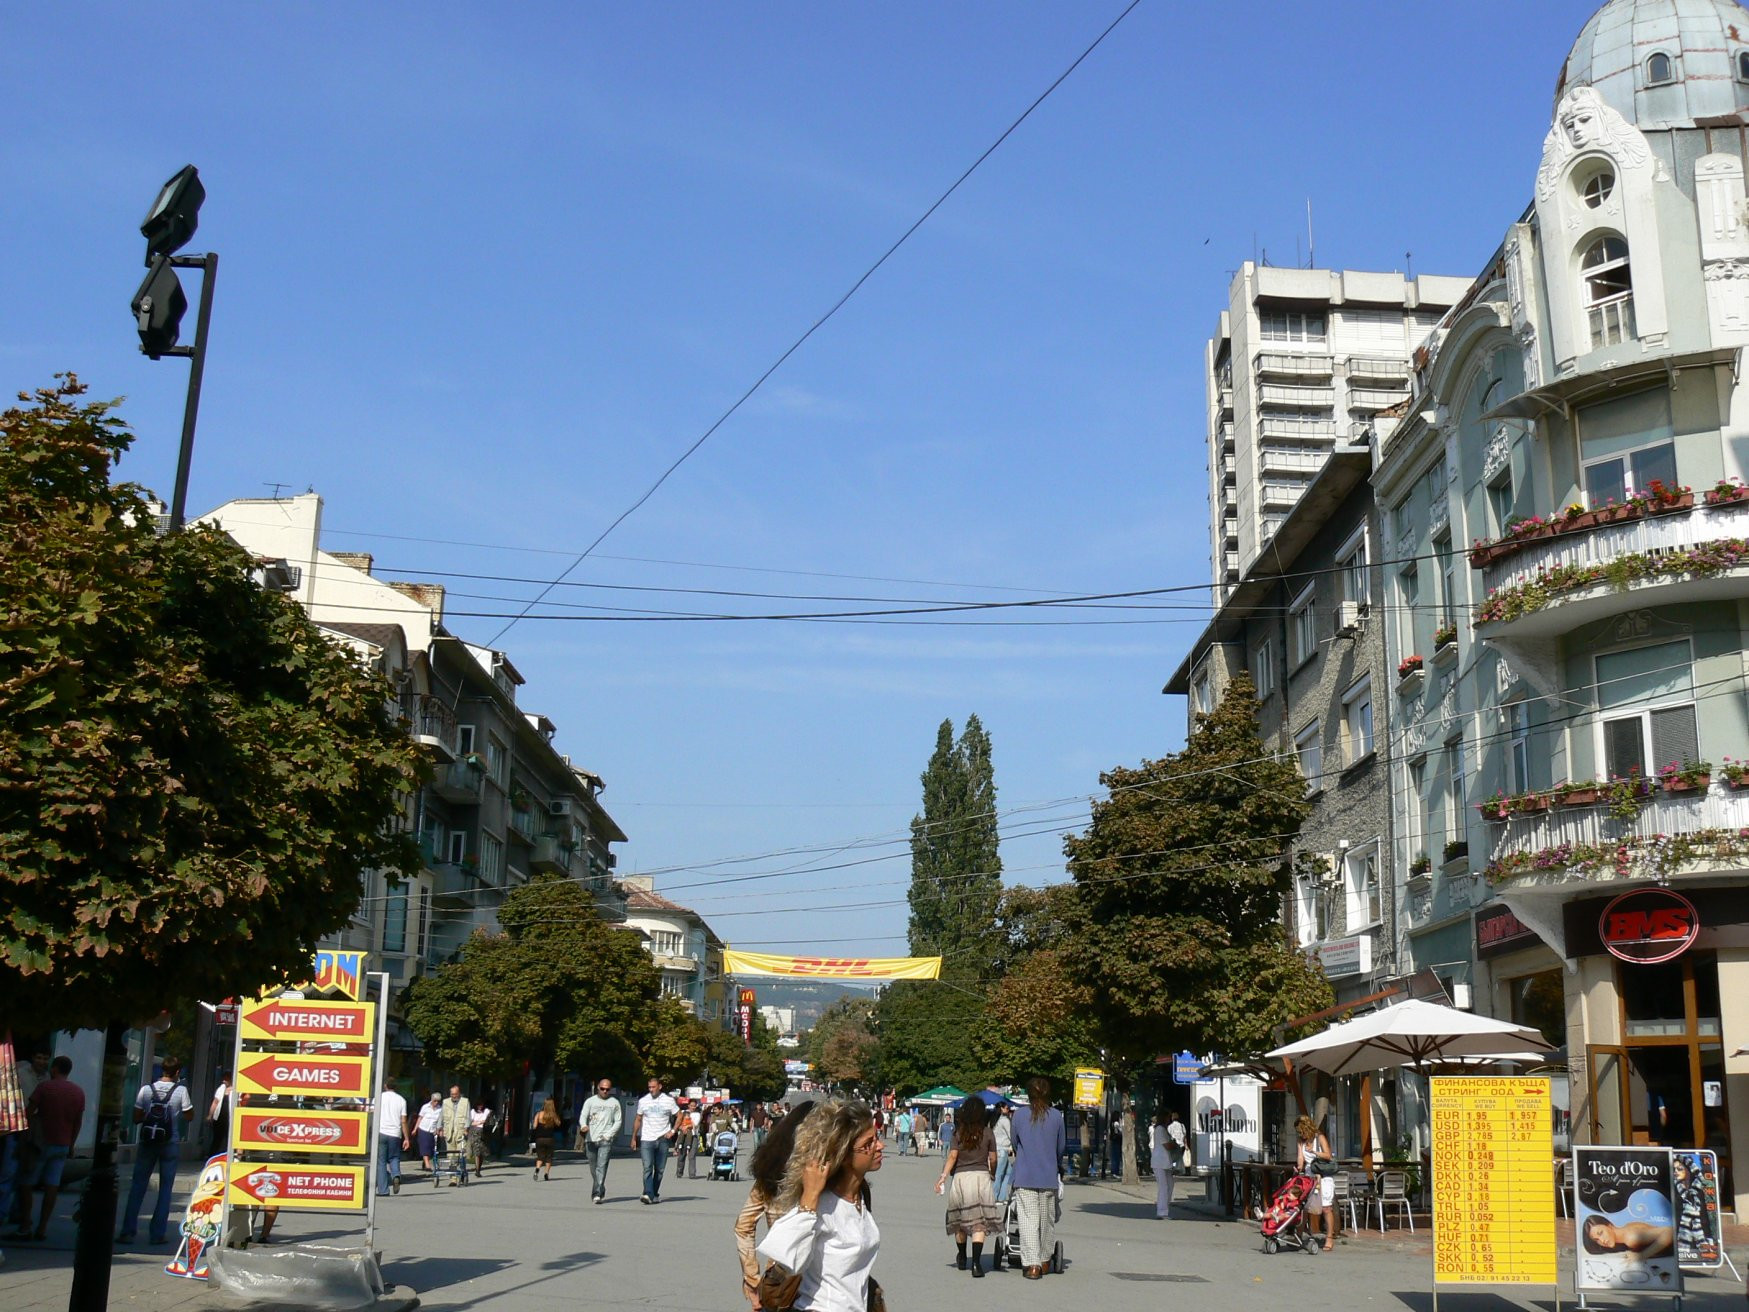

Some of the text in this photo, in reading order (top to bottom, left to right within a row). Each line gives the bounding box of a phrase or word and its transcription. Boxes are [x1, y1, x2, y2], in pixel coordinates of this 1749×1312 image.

[1608, 908, 1690, 942] BMS
[789, 959, 873, 976] DHL
[269, 1012, 355, 1029] INTERNET
[273, 1067, 340, 1084] GAMES
[1510, 1080, 1546, 1088] КЪЩА
[1436, 1111, 1460, 1120] EUR
[1436, 1122, 1460, 1130] USD
[1436, 1132, 1460, 1140] GBP
[1436, 1142, 1460, 1150] CHF
[1436, 1152, 1462, 1160] NOK
[1436, 1162, 1459, 1170] SEK
[1588, 1160, 1658, 1175] Teo d'Oro
[1437, 1172, 1461, 1180] DKK
[288, 1176, 352, 1187] NET PHONE
[1436, 1182, 1460, 1190] CAD
[1437, 1192, 1460, 1200] CYP
[1437, 1212, 1462, 1221] RUR
[1439, 1223, 1460, 1231] PLZ
[1438, 1233, 1462, 1241] HUF
[1437, 1243, 1461, 1252] CZK
[1438, 1253, 1462, 1262] SKK
